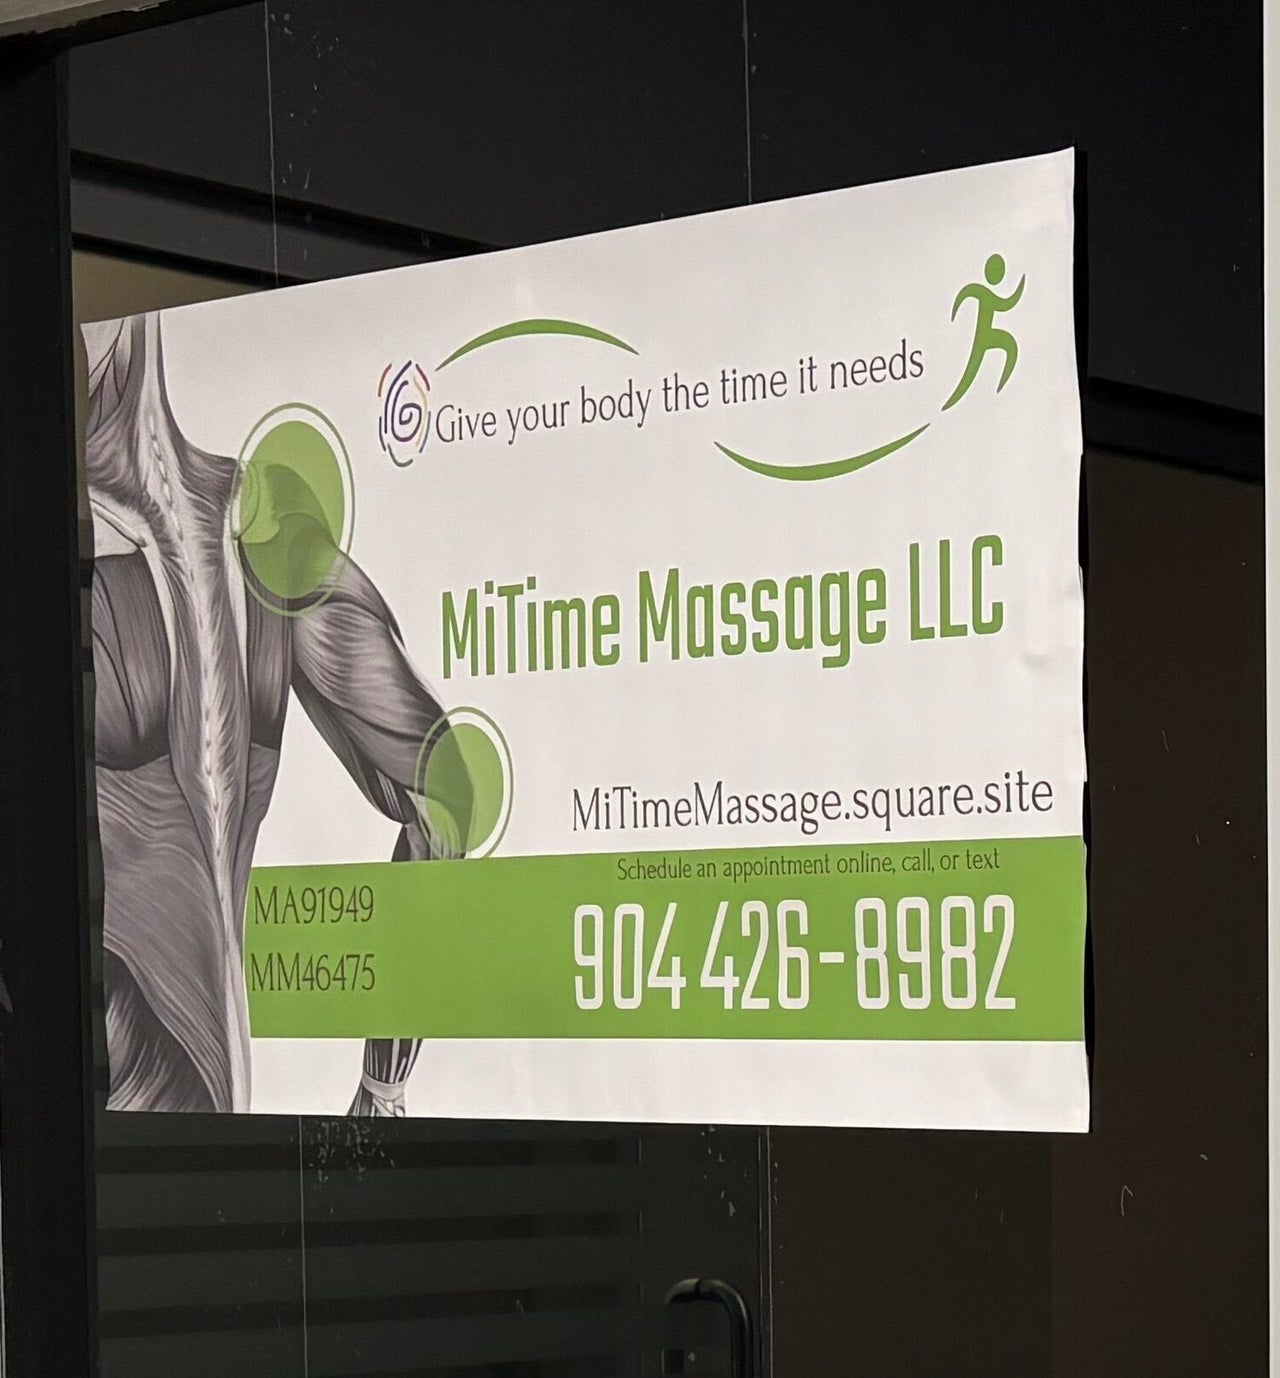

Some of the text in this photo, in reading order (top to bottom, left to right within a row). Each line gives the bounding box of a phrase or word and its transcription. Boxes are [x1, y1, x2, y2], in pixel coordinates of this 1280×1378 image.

[436, 338, 925, 446] Give your body the time it needs
[442, 534, 1004, 680] MiTime Massage LLC
[572, 769, 1054, 835] MiTimeMassage.square.site
[616, 847, 1000, 883] Schedule an appointment online, call, or text
[254, 884, 374, 925] MA91949
[251, 951, 376, 992] MM46475
[572, 894, 1018, 1011] 904 426-8982
